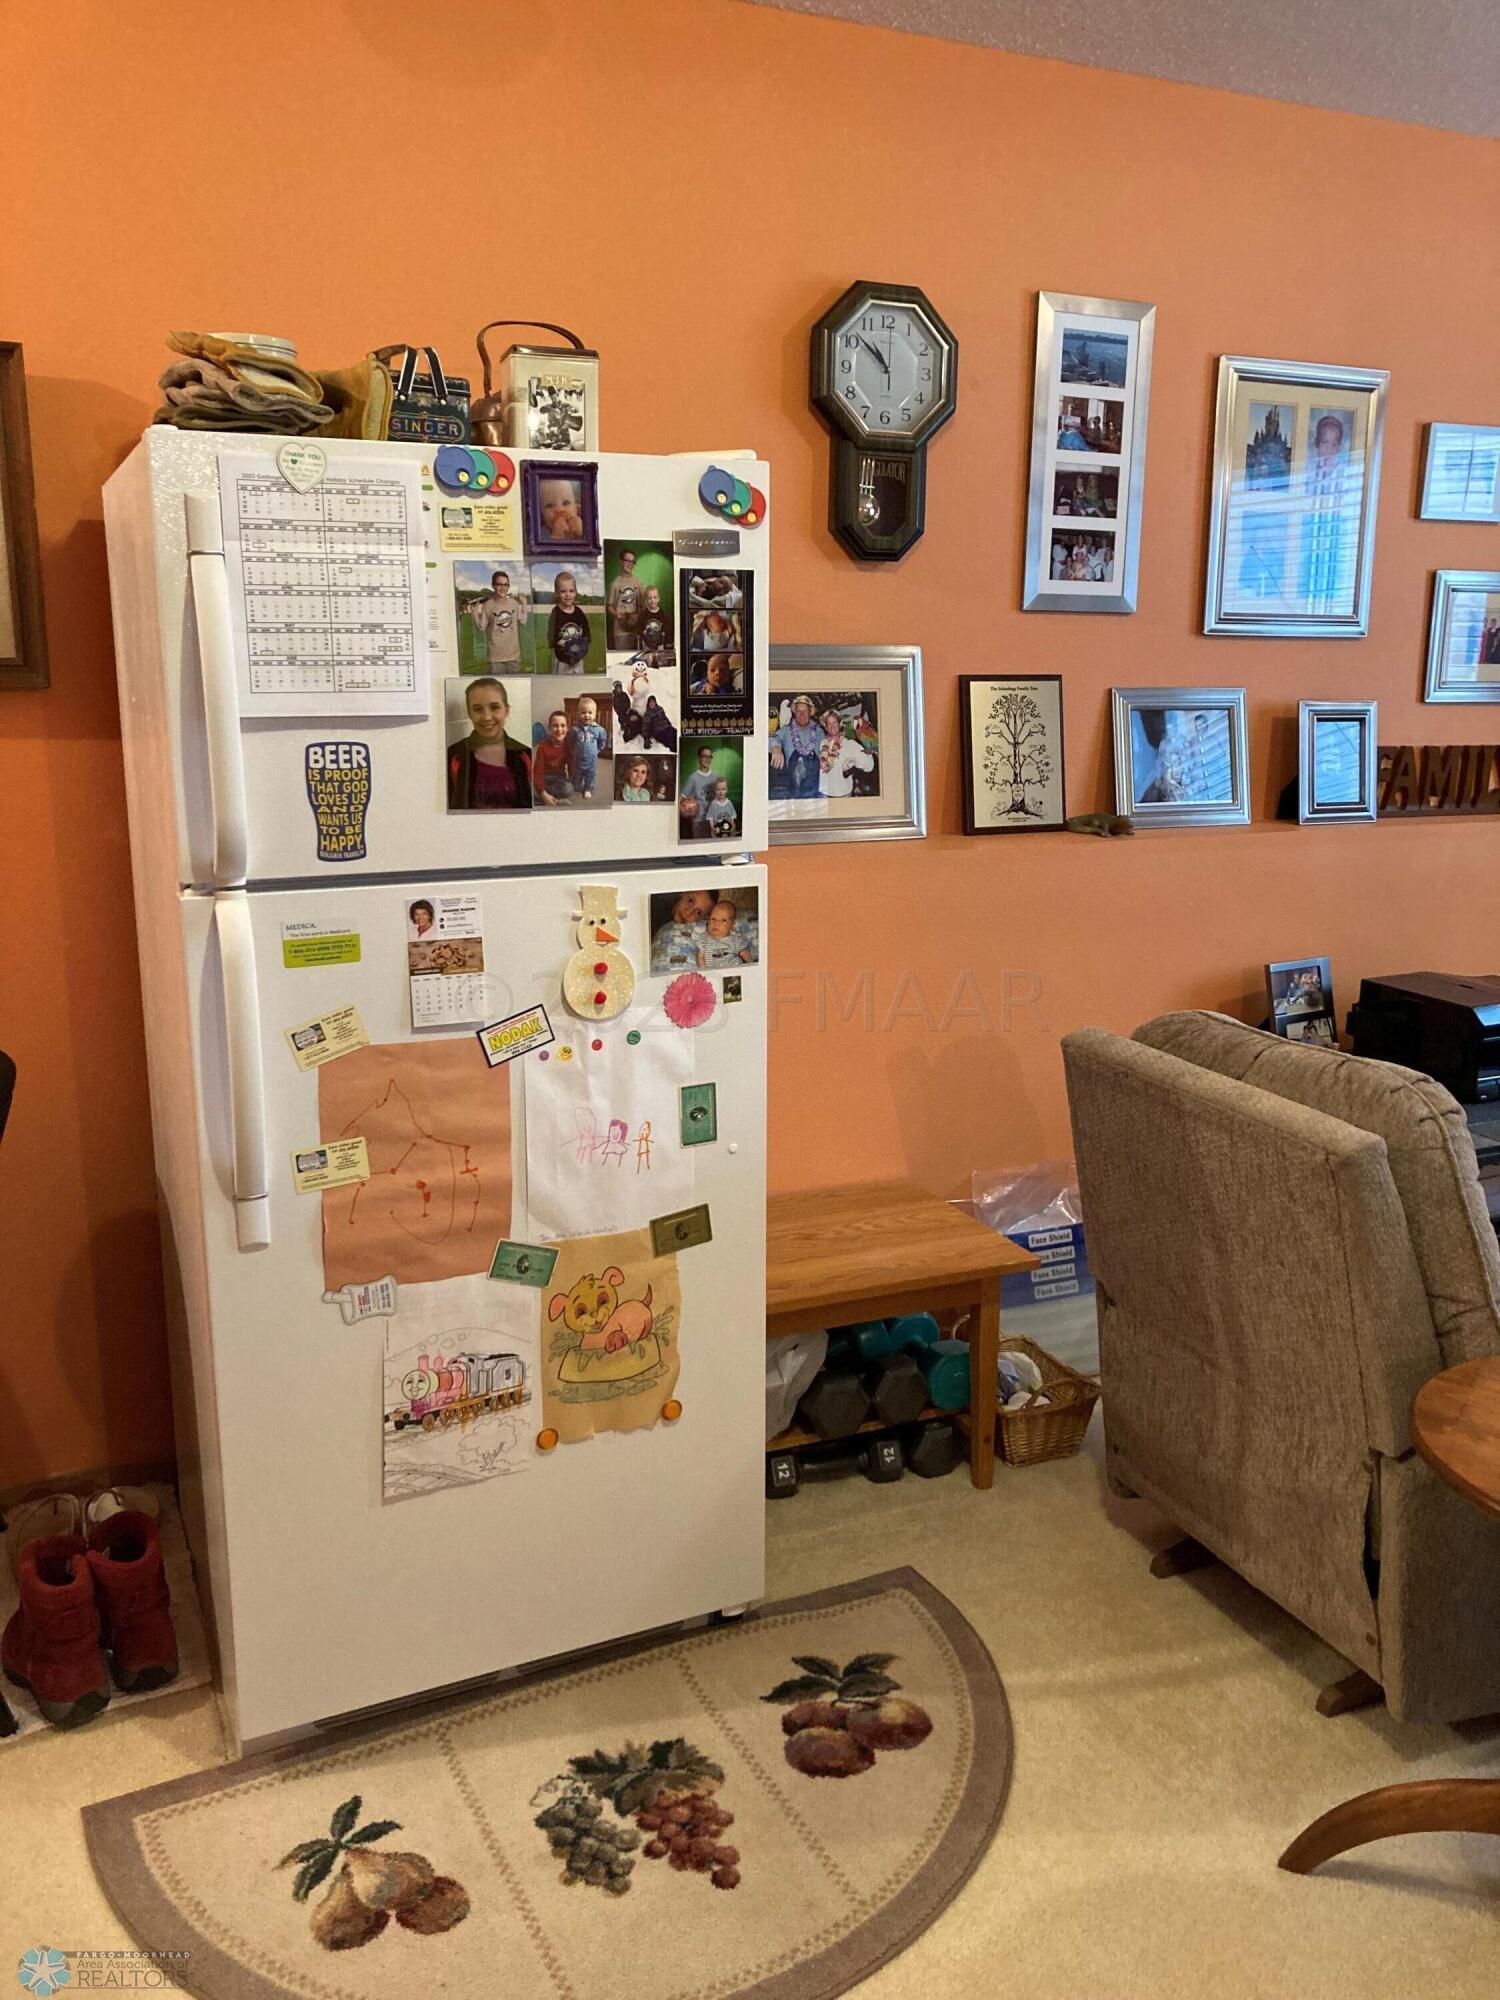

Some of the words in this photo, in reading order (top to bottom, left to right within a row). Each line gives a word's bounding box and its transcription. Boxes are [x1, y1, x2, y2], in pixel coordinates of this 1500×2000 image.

[862, 317, 874, 331] 11
[881, 315, 895, 329] 12
[906, 323, 911, 336] 1
[844, 334, 859, 348] 10
[919, 343, 928, 356] 2
[841, 359, 851, 374] 9
[921, 368, 931, 382] 3
[845, 386, 856, 399] 8
[915, 392, 925, 404] 4
[860, 406, 871, 419] 7
[880, 411, 890, 424] 6
[901, 409, 911, 422] 5
[391, 418, 458, 436] SINGER
[309, 744, 368, 769] BEER
[308, 769, 320, 781] IS
[324, 768, 368, 781] PROOF
[1377, 745, 1500, 808] FAMIL
[309, 781, 340, 793] THAT
[343, 780, 368, 793] GOD
[311, 793, 348, 806] LOVES
[351, 792, 368, 804] US
[318, 805, 364, 813] AND
[318, 813, 349, 826] WANTS
[351, 812, 363, 824] US
[320, 826, 340, 835] TO
[345, 824, 363, 835] BE
[488, 1017, 543, 1051] NODAK
[1031, 1236, 1047, 1245] Face
[1049, 1232, 1070, 1241] Shield
[1051, 1249, 1073, 1258] Shield
[1034, 1270, 1050, 1279] Face
[1051, 1266, 1073, 1276] Shield
[1037, 1287, 1053, 1296] Face
[1054, 1282, 1076, 1292] Shield
[883, 1447, 895, 1464] 12
[777, 1463, 790, 1480] 12
